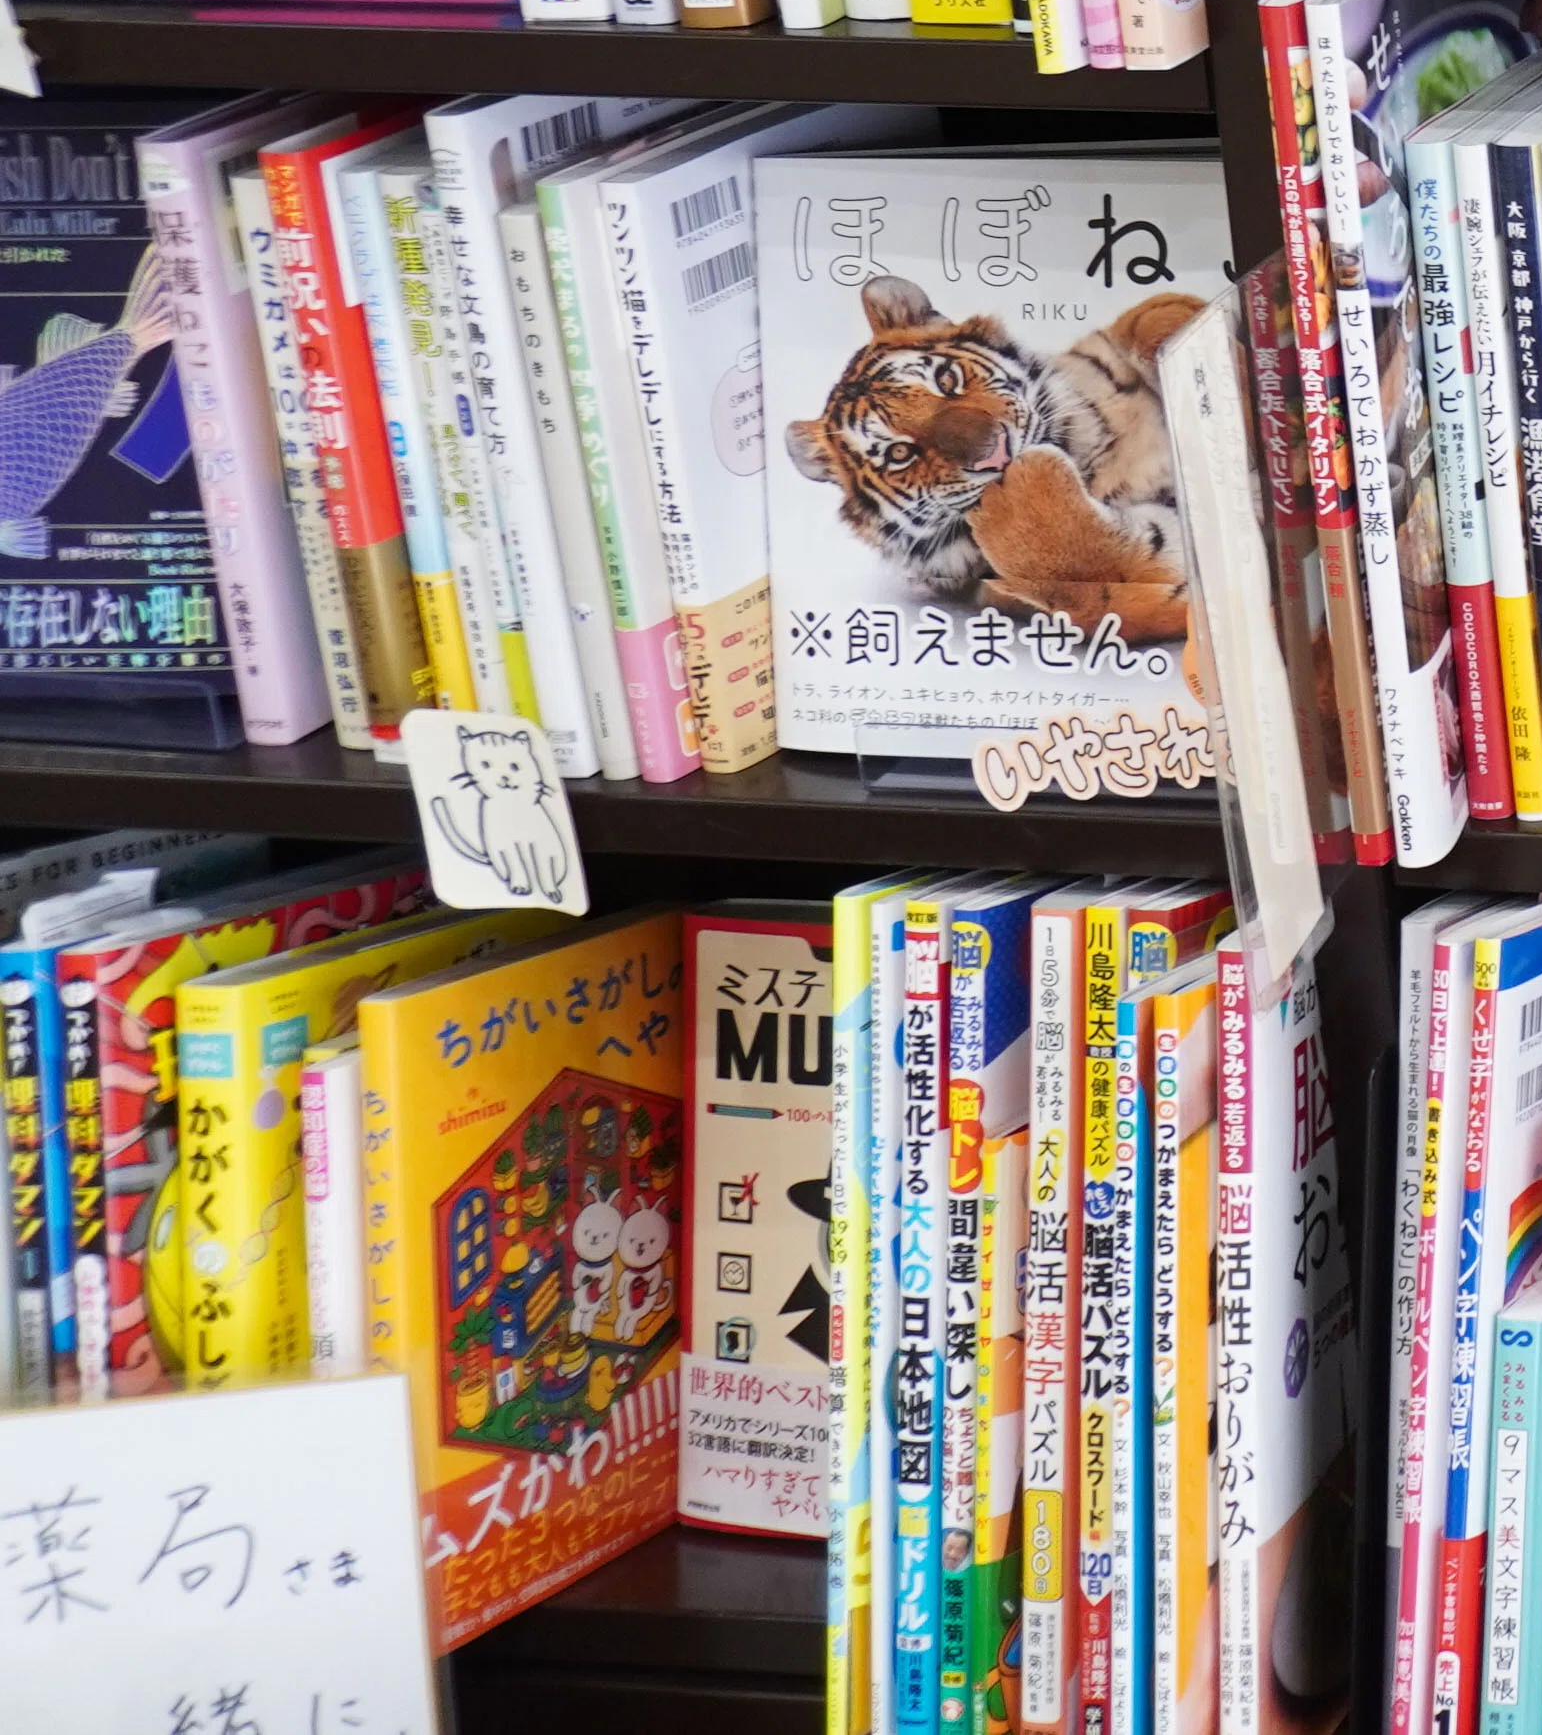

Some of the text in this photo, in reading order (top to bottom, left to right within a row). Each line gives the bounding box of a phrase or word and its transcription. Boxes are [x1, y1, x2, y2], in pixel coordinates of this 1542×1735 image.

[444, 205, 507, 455] 幸せな文鳥の育て方
[509, 248, 557, 435] おもちのきもち
[1021, 302, 1089, 323] RIKU
[1341, 306, 1390, 569] せいろでおかず蒸し
[790, 611, 1171, 677] ※飼えません。
[1396, 796, 1414, 851] Gakken
[436, 1099, 510, 1136] shimizu
[1026, 1211, 1069, 1484] 脳活漢字パズル
[1080, 1224, 1115, 1400] 脳活パズル
[1217, 1183, 1258, 1549] 脳活性おりがみ
[1446, 1208, 1487, 1471] ペン字練習帳
[4, 1480, 364, 1622] 薬局 さま
[1489, 1434, 1523, 1702] 9マス美文字練習帳
